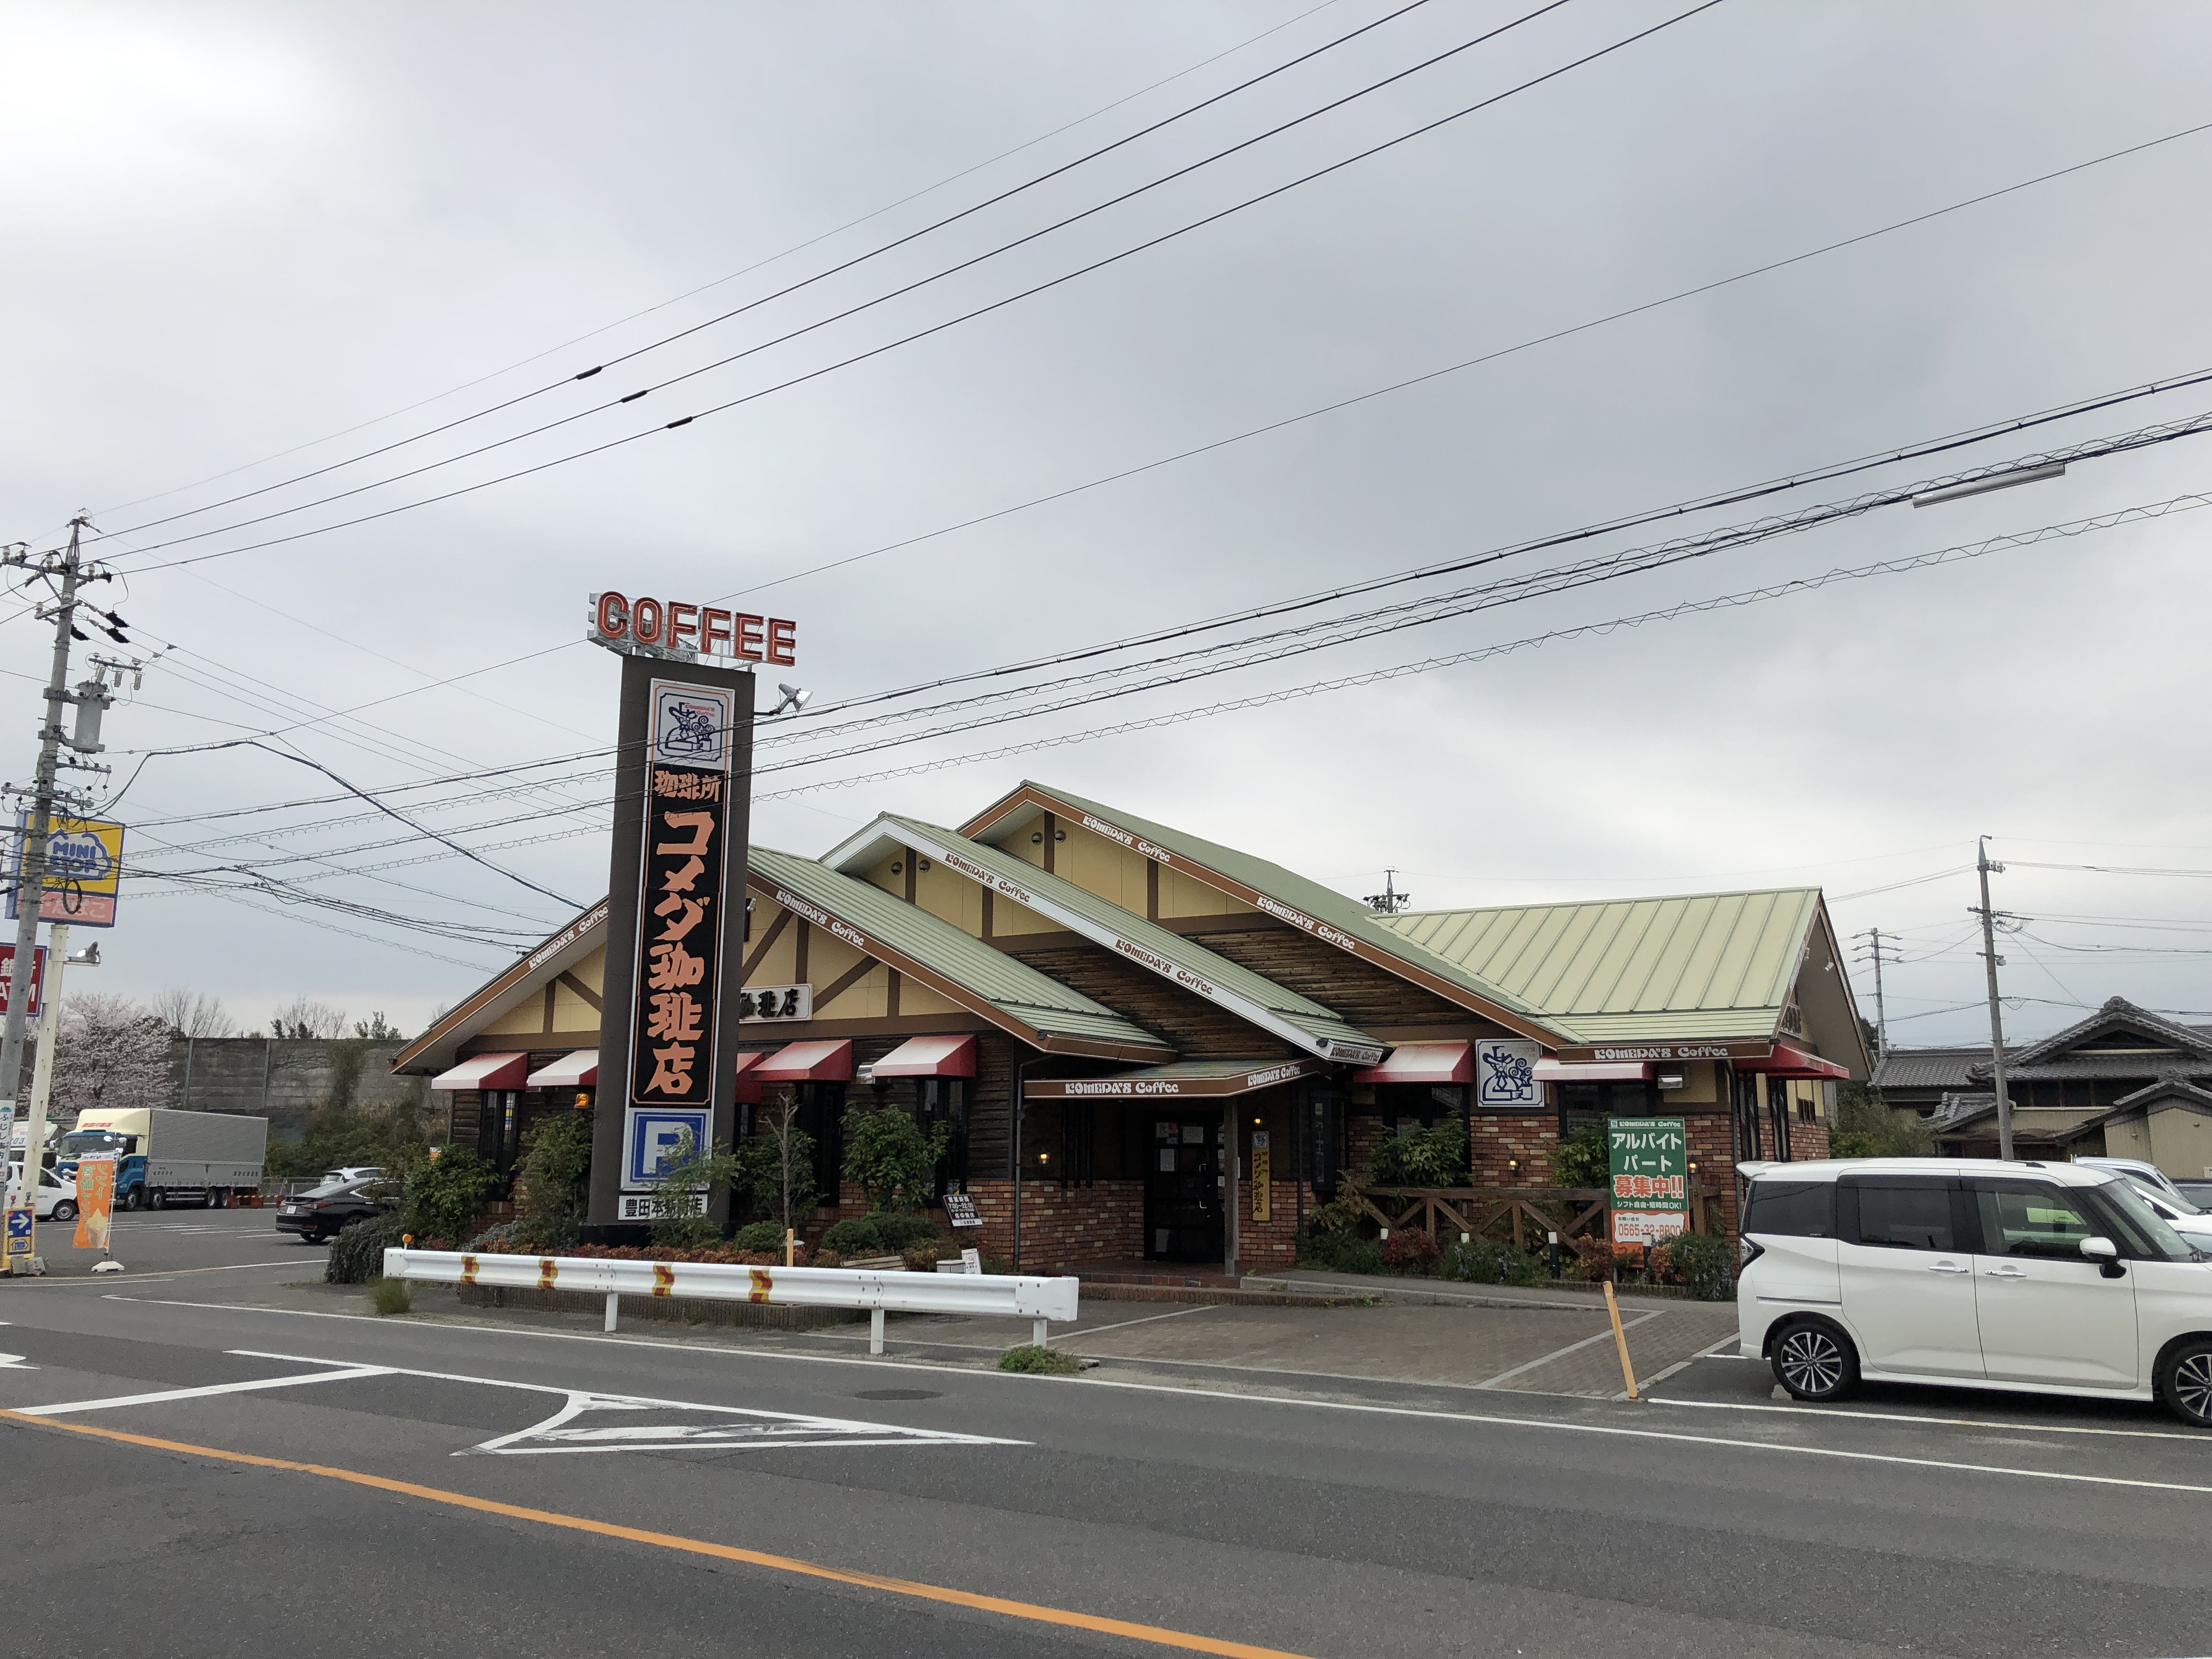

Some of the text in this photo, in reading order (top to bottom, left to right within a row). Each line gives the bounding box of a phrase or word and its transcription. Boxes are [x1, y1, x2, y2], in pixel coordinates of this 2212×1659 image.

[597, 591, 796, 667] COFFEE
[654, 770, 721, 802] 珈琲所
[53, 841, 96, 859] MINI
[1082, 815, 1170, 862] KOMEDA'S Coffee
[945, 853, 1030, 902] KOMEDA'S Coffee
[776, 890, 864, 946] KOMEDA'S Coffee
[1256, 896, 1355, 950] KOMEDA'S Coffee
[529, 929, 575, 969] KOMEDA'S
[644, 811, 715, 1095] コメダ珈琲店
[1115, 939, 1213, 995] KOMEDA'S Coffee
[1594, 1046, 1729, 1059] KOMEDA'S Coffee
[1065, 1082, 1179, 1094] KOMEDA'S Coffee
[1248, 1065, 1300, 1087] KOMEDA'S Coffee
[643, 1120, 694, 1175] P
[1612, 1132, 1682, 1150] アルバイト
[1624, 1154, 1672, 1172] パート
[1613, 1175, 1684, 1199] 募集中!!
[624, 1198, 703, 1217] 豊田本
